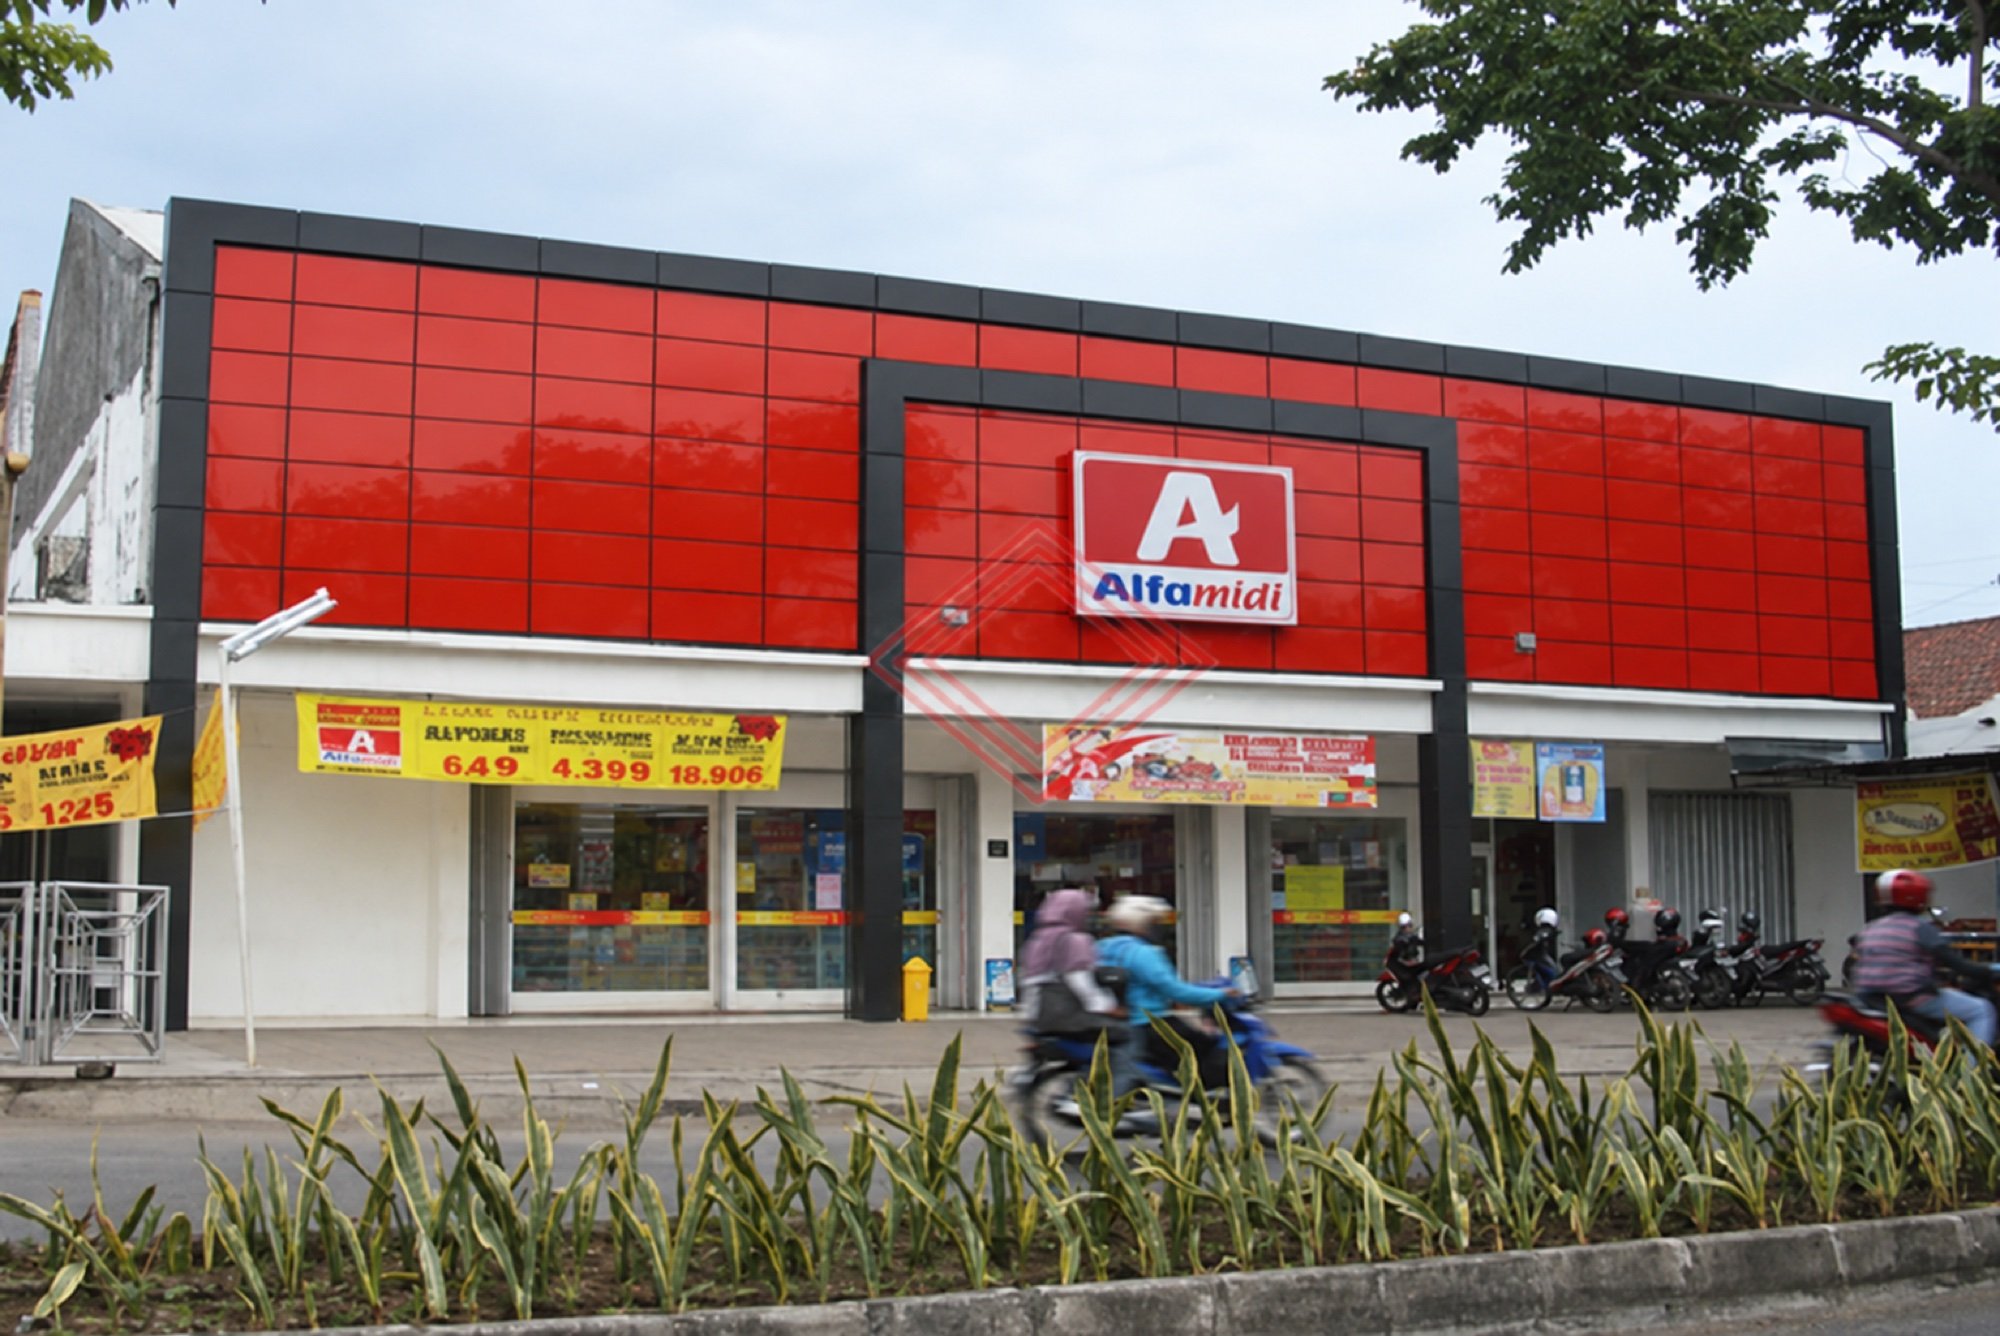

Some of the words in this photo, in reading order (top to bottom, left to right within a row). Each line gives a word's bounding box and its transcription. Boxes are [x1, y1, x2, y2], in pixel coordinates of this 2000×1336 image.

[1093, 572, 1283, 612] Alfamidi
[552, 757, 652, 782] 4.399
[669, 764, 764, 785] 18.906
